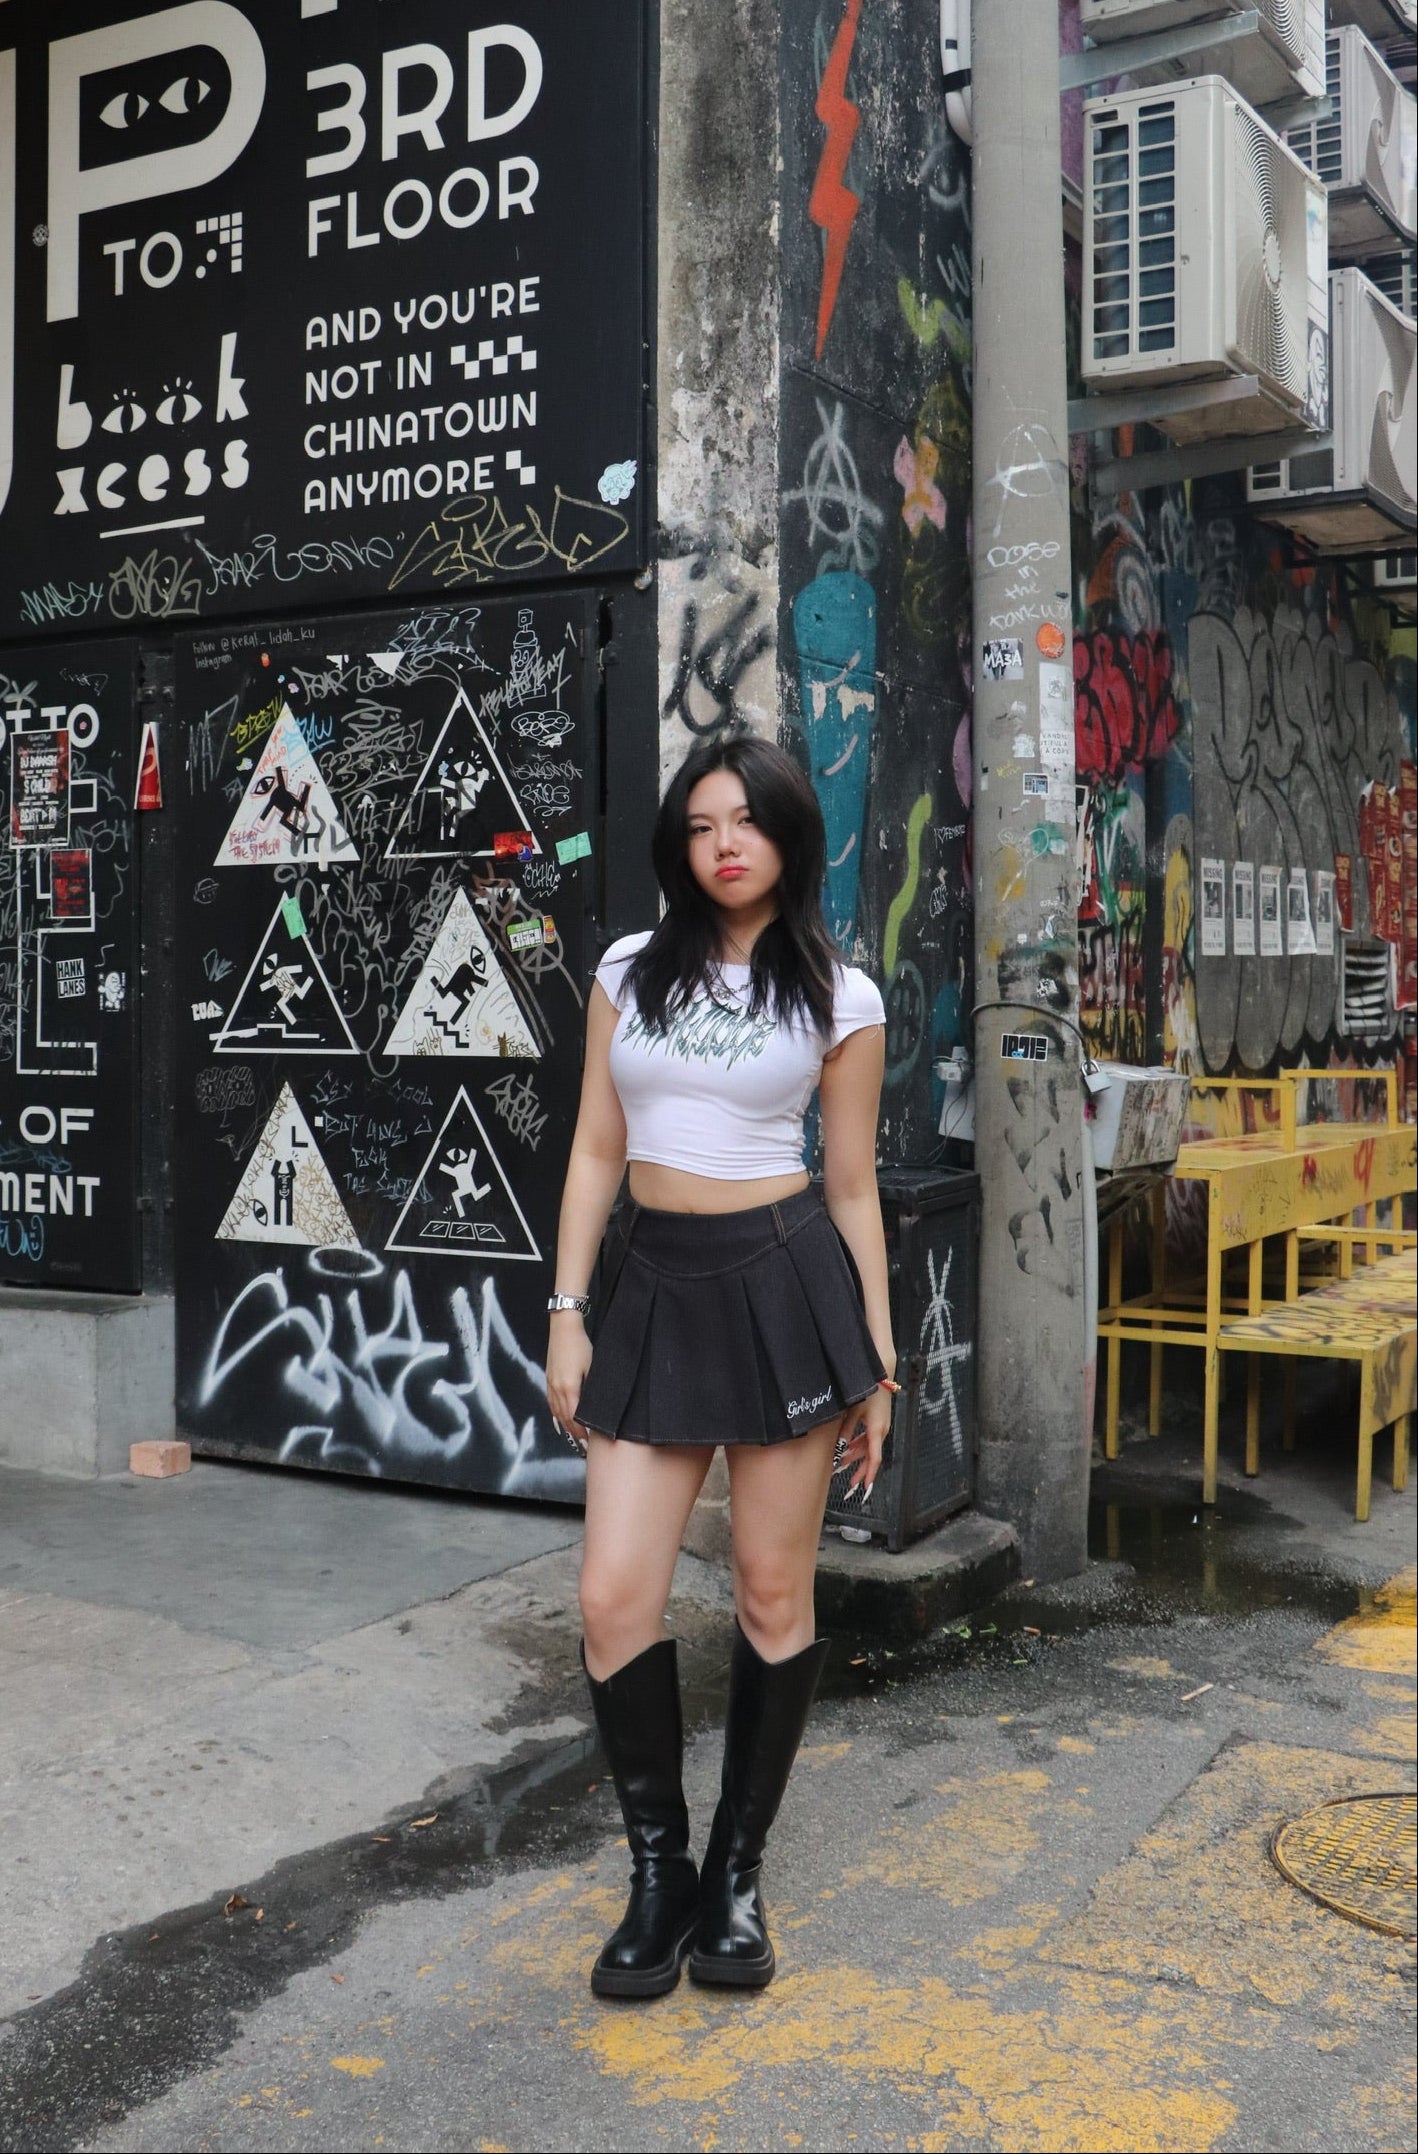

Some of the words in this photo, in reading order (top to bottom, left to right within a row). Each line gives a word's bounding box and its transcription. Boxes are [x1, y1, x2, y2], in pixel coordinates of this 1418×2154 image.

[306, 24, 544, 179] 3RD
[307, 155, 540, 257] FLOOR
[103, 231, 184, 296] TO
[305, 307, 382, 351] AND
[394, 276, 541, 335] YOU'RE
[305, 359, 382, 404] NOT
[397, 352, 433, 390] IN
[304, 391, 538, 459] CHINATOWN
[304, 454, 494, 514] ANYMORE
[1203, 867, 1223, 880] MISSING
[57, 960, 83, 978] HANK
[58, 979, 86, 998] LANES
[19, 1106, 94, 1144] OF
[786, 1398, 811, 1419] Girl's
[809, 1385, 833, 1413] girl
